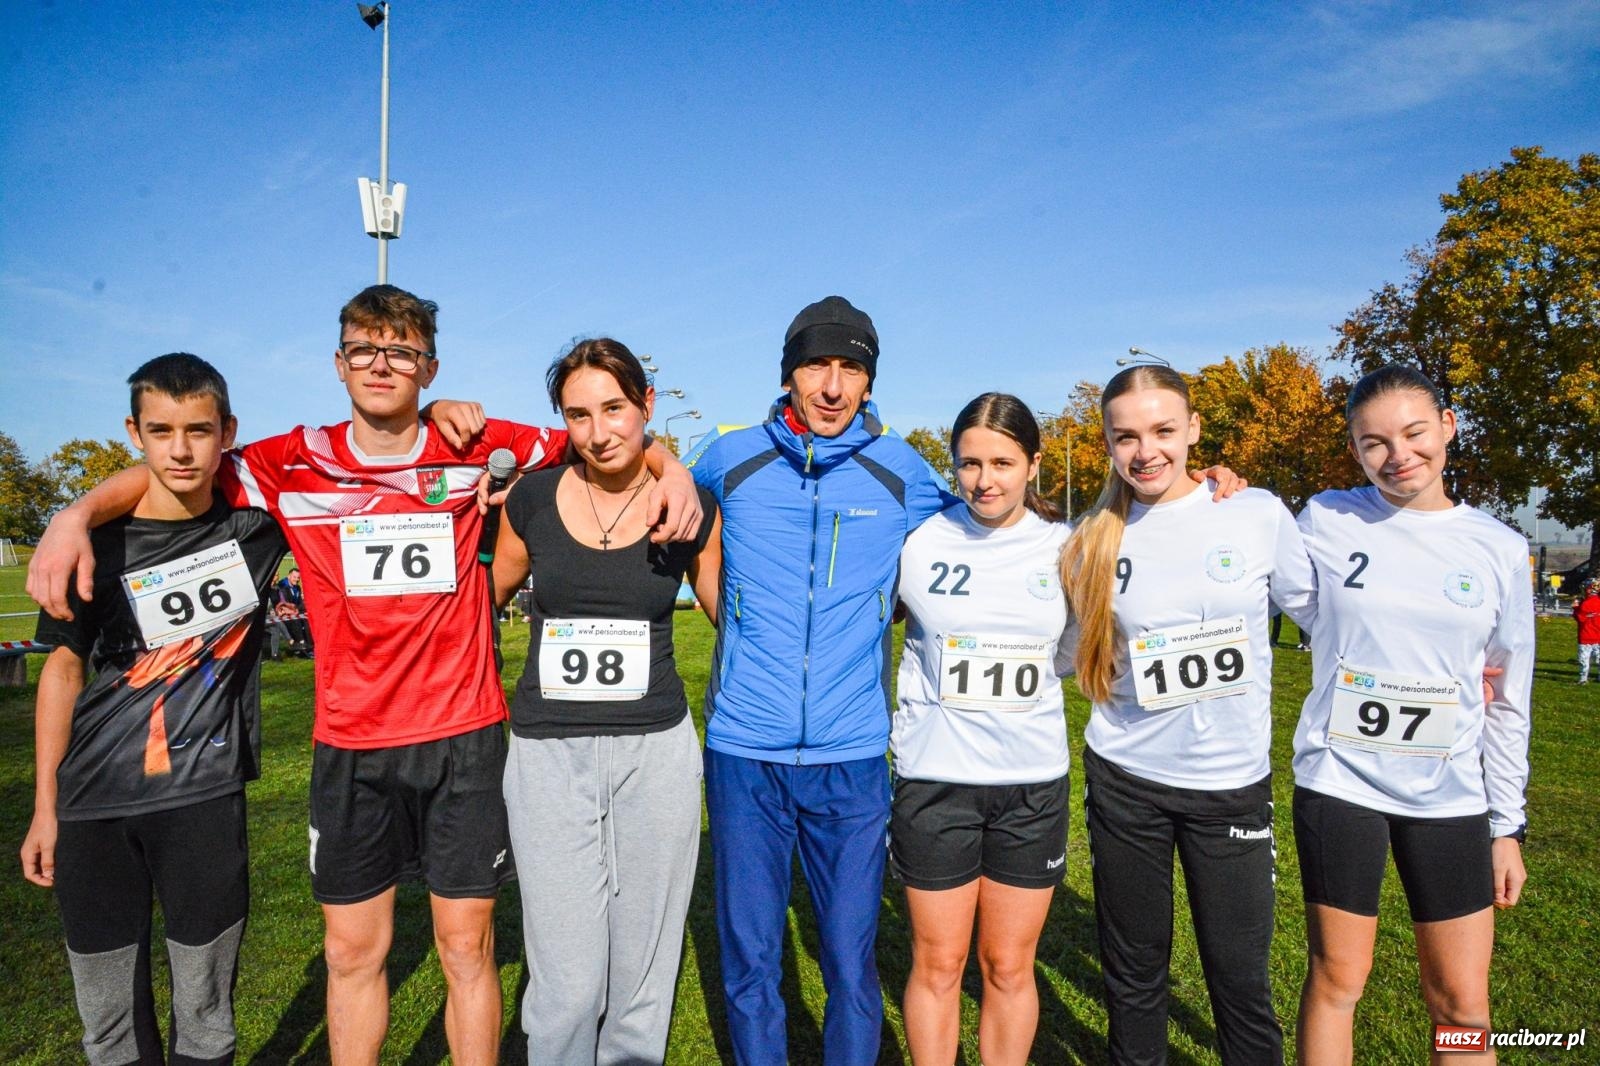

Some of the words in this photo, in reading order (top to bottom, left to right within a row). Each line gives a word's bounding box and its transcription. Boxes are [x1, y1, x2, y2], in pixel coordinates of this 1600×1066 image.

[380, 521, 449, 531] www.personalbest.pl
[167, 549, 237, 578] www.personalbest.pl
[365, 543, 431, 580] 76
[928, 561, 971, 596] 22
[1344, 551, 1370, 590] 2
[161, 579, 231, 626] 96
[1171, 625, 1243, 643] www.personalbest.pl
[562, 648, 624, 686] 98
[949, 660, 1039, 698] 110
[1144, 648, 1244, 695] 109
[1381, 681, 1455, 694] www.personalbest.pl
[1357, 700, 1432, 741] 97
